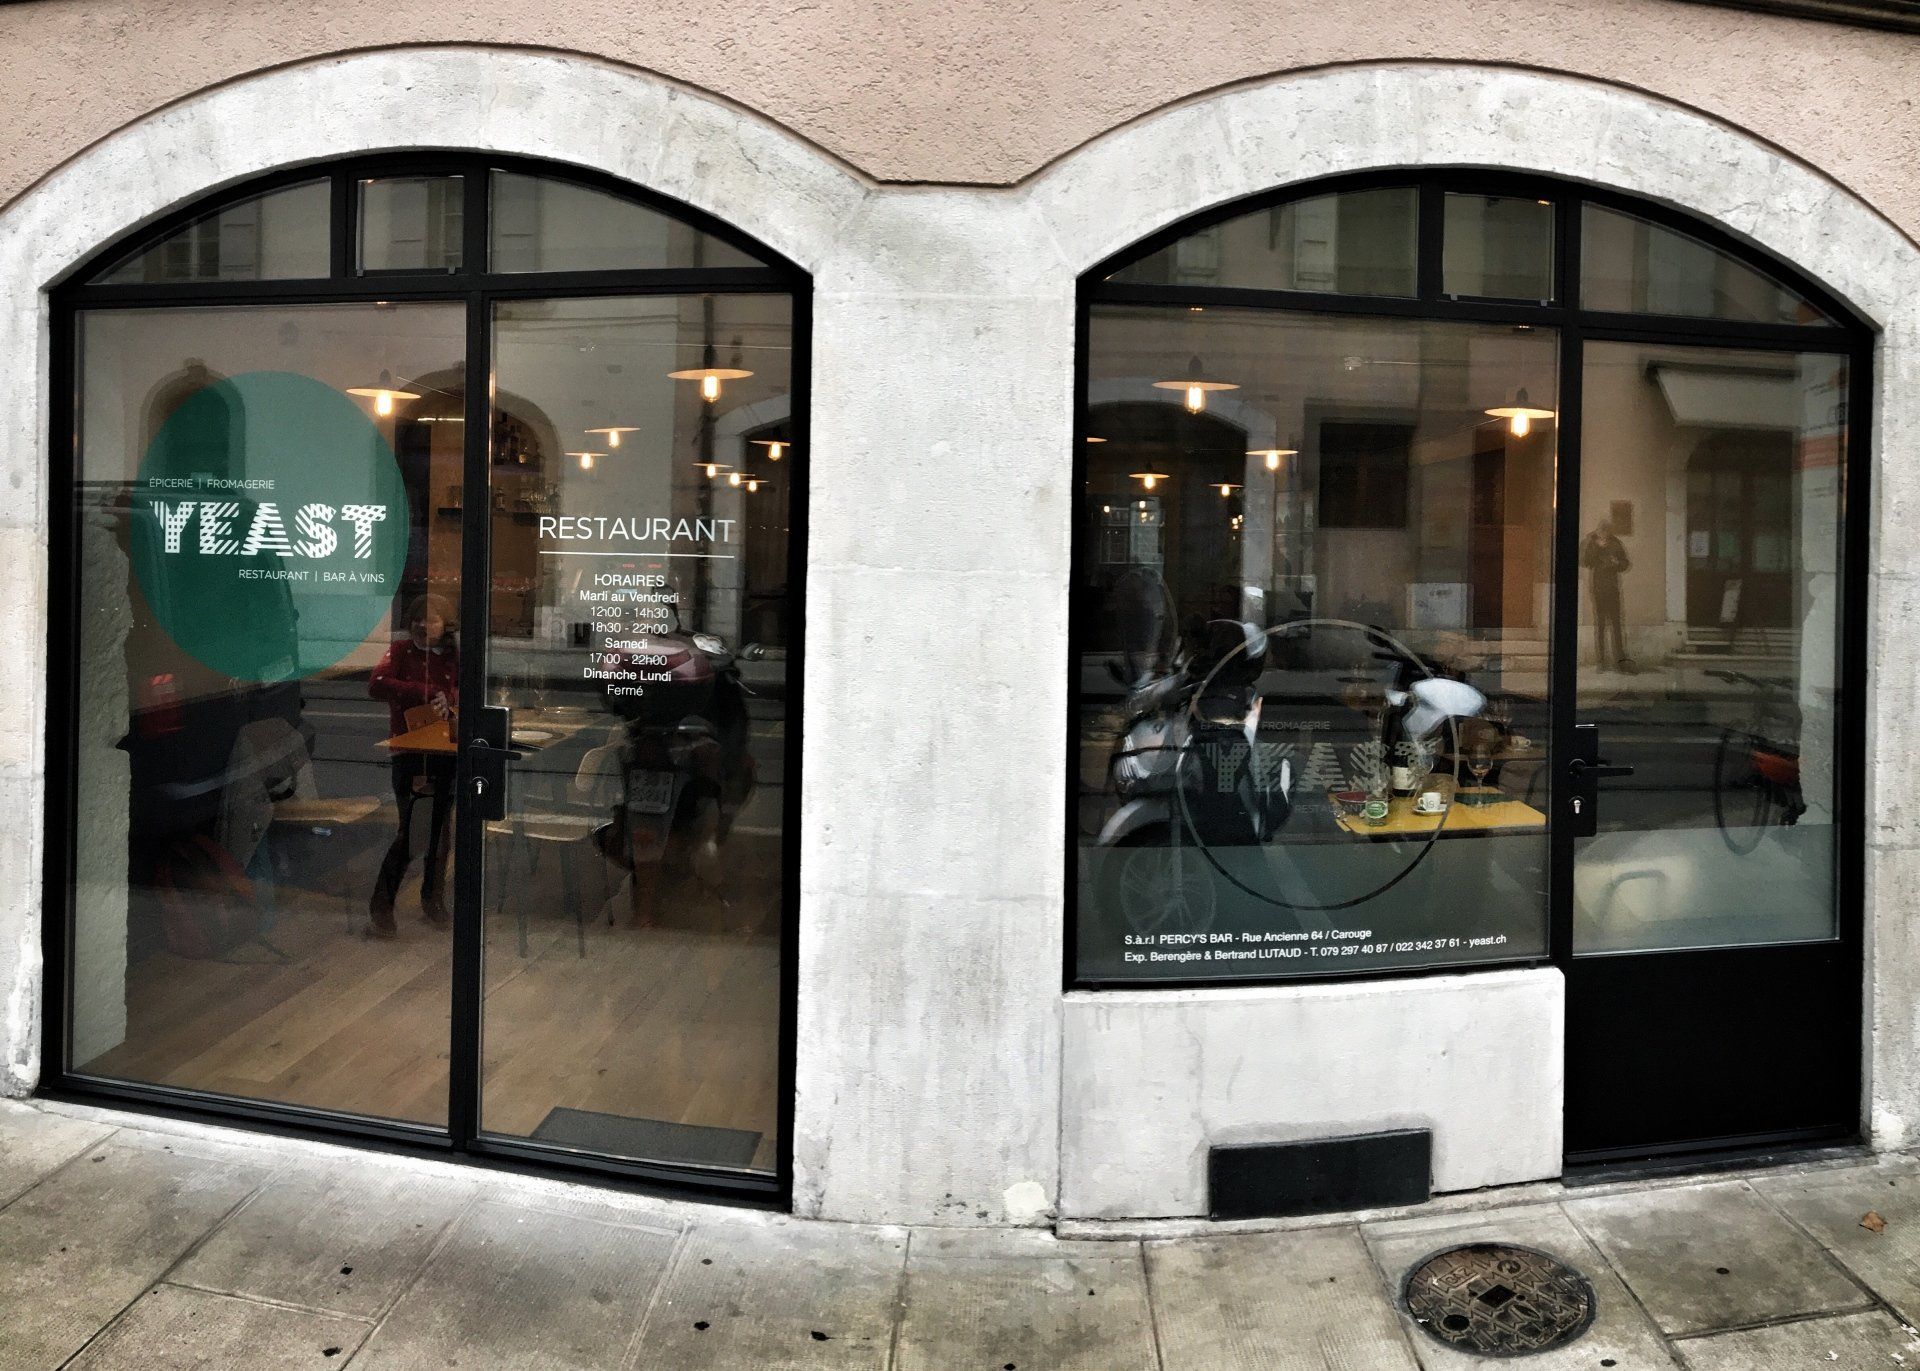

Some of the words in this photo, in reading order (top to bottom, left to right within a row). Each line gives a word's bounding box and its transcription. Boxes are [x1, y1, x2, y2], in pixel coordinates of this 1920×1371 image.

[149, 477, 194, 488] ÉPICERIE
[207, 479, 275, 490] FROMAGERIE
[149, 501, 387, 559] YEAST
[538, 516, 737, 542] RESTAURANT
[238, 569, 309, 581] RESTAURANT
[323, 572, 345, 582] BAR
[348, 569, 357, 582] À
[360, 573, 385, 583] VINS
[594, 574, 665, 587] HORAIRES
[611, 593, 625, 602] au
[629, 591, 679, 603] Vendredi
[634, 607, 669, 619] 14h30
[632, 623, 669, 635] 22h00
[604, 638, 648, 650] Samedi
[631, 654, 667, 666] 22h00
[640, 669, 672, 682] Lundi
[607, 684, 644, 697] Fermé
[1262, 720, 1331, 731] FROMAGERIE
[1159, 933, 1207, 944] PERCY'S
[1210, 933, 1233, 944] BAR
[1242, 932, 1262, 943] Rue
[1263, 931, 1309, 942] Ancienne
[1311, 930, 1323, 940] 64
[1331, 929, 1372, 940] Carouge
[1124, 951, 1147, 964] Exp.
[1150, 950, 1202, 963] Berengère
[1204, 950, 1212, 961] &
[1214, 949, 1257, 961] Bertrand
[1258, 948, 1302, 959] LUTAUD
[1310, 946, 1319, 957] T.
[1320, 946, 1339, 957] 079
[1341, 946, 1359, 956] 297
[1361, 944, 1374, 955] 40
[1376, 943, 1388, 954] 87
[1395, 942, 1414, 952] 022
[1415, 940, 1433, 951] 342
[1434, 939, 1447, 949] 37
[1449, 938, 1460, 948] 61
[1469, 934, 1507, 948] yeast.ch
